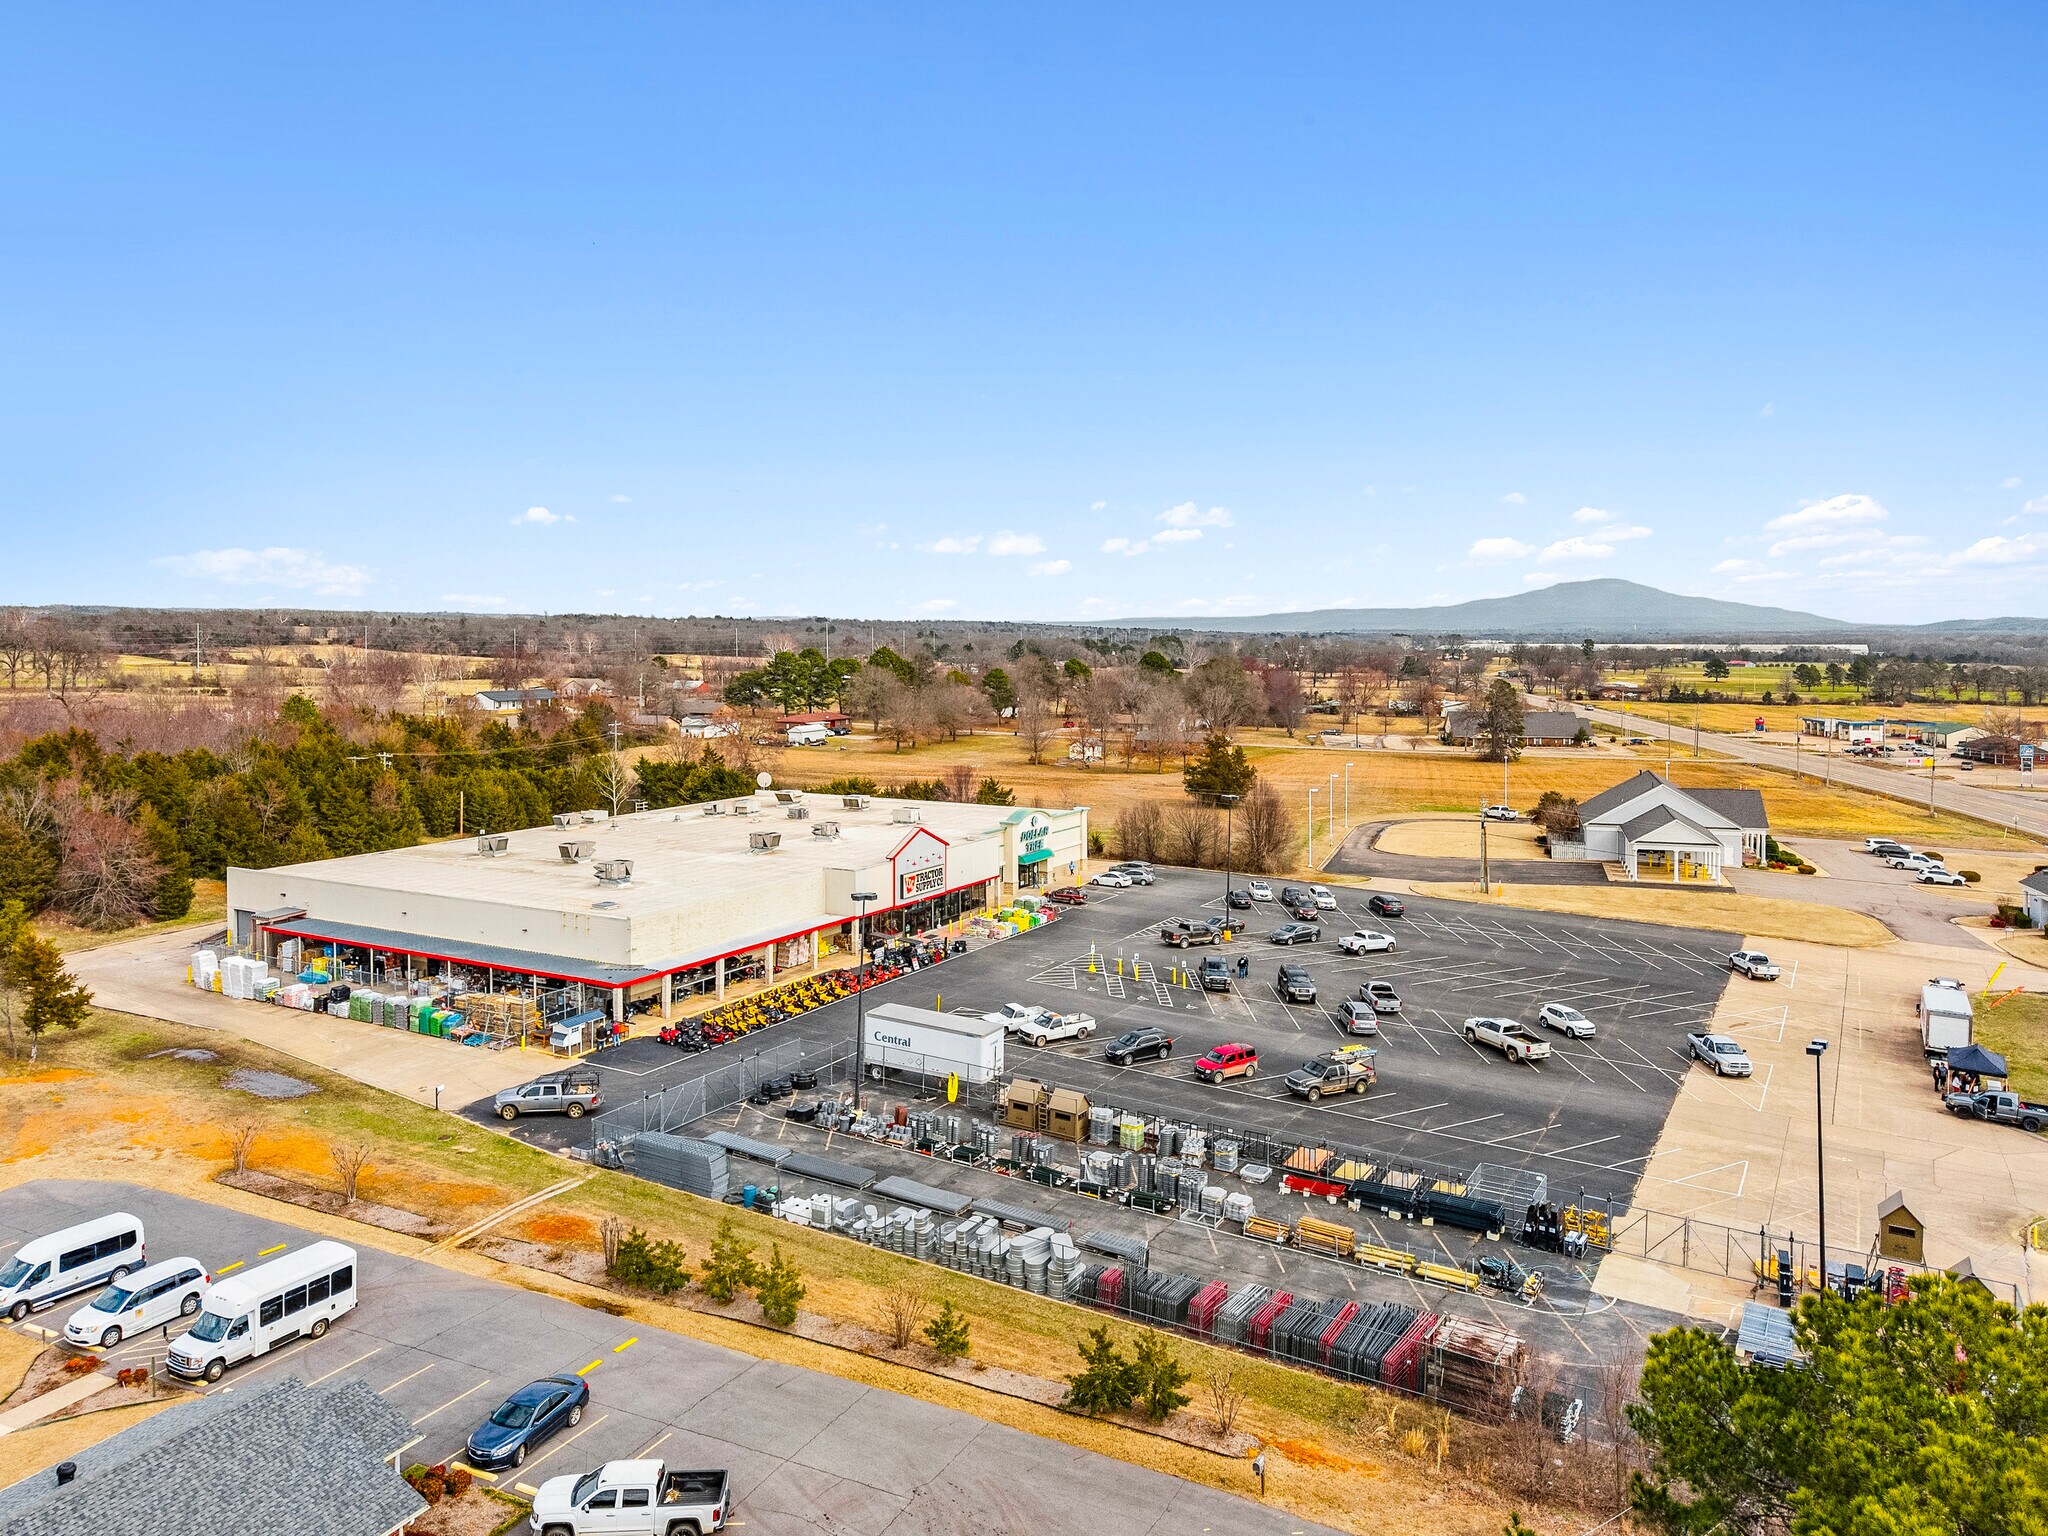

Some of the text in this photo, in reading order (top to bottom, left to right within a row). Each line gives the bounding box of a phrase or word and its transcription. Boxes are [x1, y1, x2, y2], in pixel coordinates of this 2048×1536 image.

[1020, 826, 1049, 842] DOLLAR
[1025, 839, 1044, 853] TREE
[916, 868, 943, 882] TRACTOR
[916, 878, 937, 892] SUPPLY
[874, 1031, 911, 1047] Central
